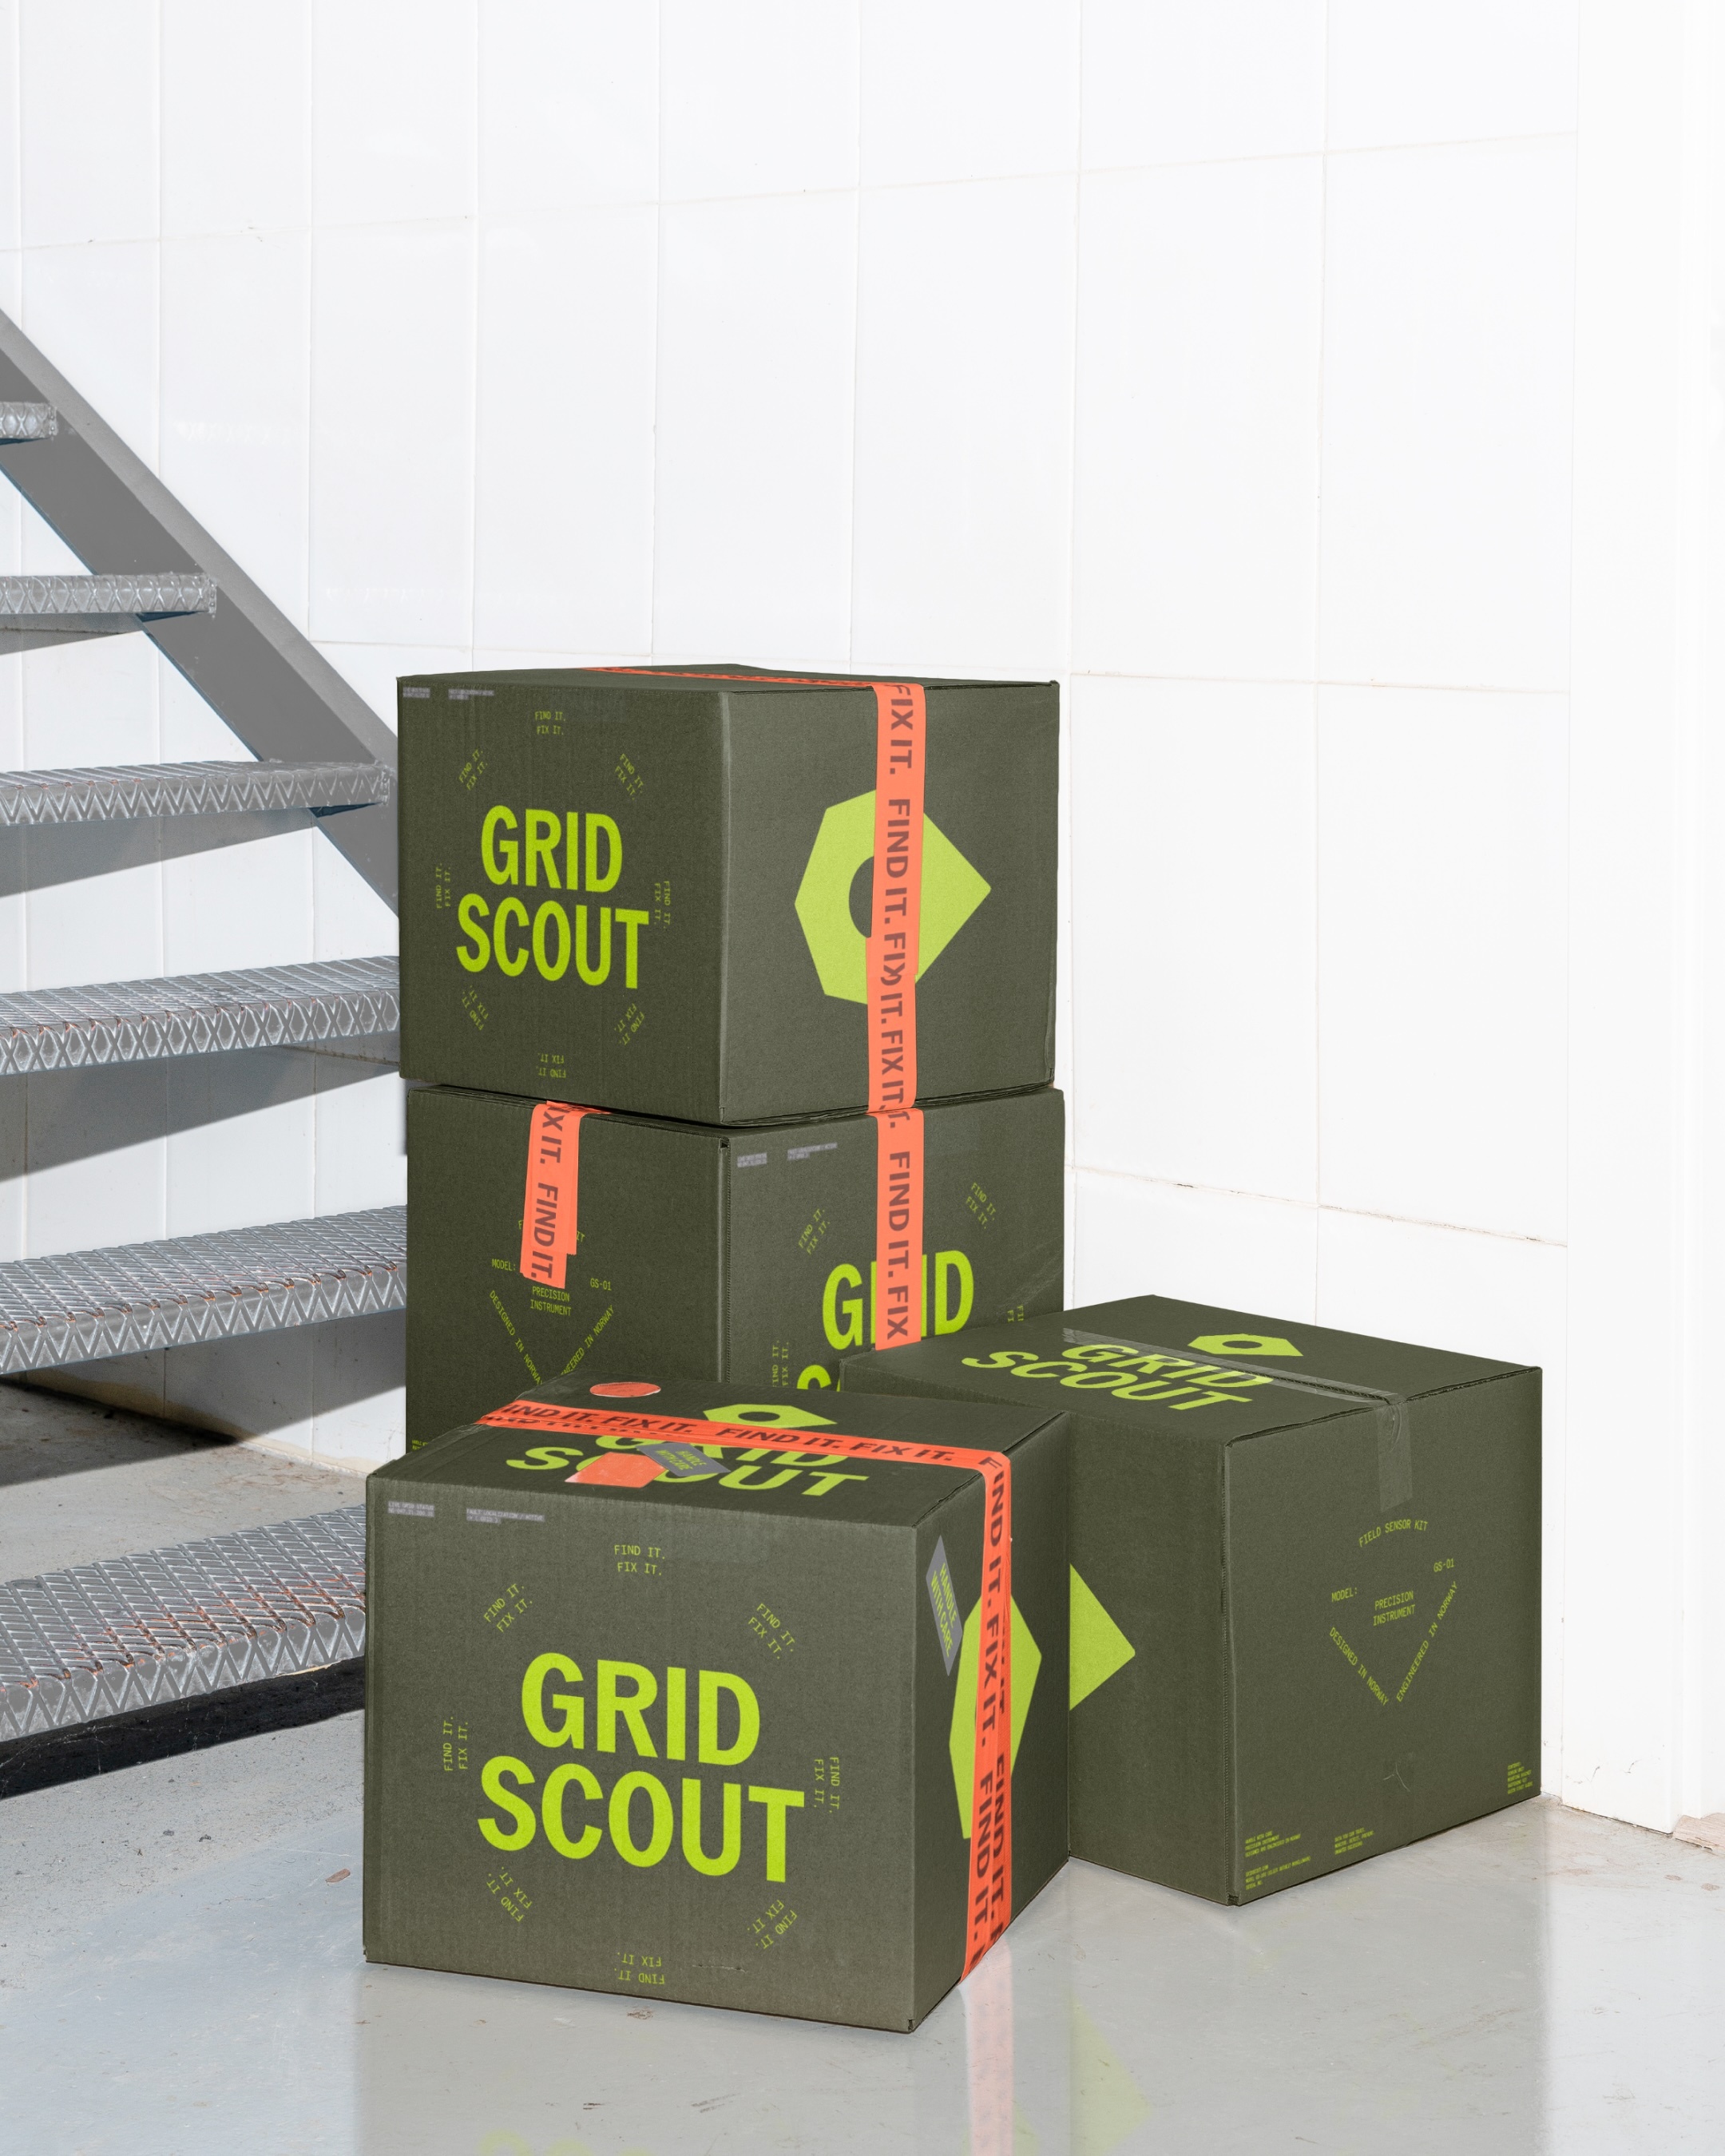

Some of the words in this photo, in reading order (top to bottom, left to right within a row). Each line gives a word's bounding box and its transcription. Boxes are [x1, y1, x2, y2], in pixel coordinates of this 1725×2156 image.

[535, 711, 551, 720] FIND
[890, 686, 914, 731] FIX
[537, 725, 549, 735] FIX
[621, 754, 634, 774] FIND
[889, 739, 913, 775] IT.
[459, 763, 471, 783] FIND
[466, 774, 477, 790] FIX
[615, 766, 627, 783] FIX
[482, 805, 622, 892] GRID
[886, 799, 910, 878] FIND
[884, 887, 907, 925] IT.
[456, 894, 648, 989] SCOUT
[478, 1002, 488, 1019] FIX
[626, 1003, 637, 1021] FIX
[880, 993, 903, 1024] IT.
[470, 1010, 484, 1030] FIND
[631, 1011, 644, 1032] FIND
[553, 1055, 564, 1064] FIX
[881, 1029, 903, 1076] FIX
[550, 1068, 566, 1078] FIND
[543, 1106, 571, 1132] IX
[540, 1135, 564, 1165] IT.
[888, 1151, 910, 1231] FIND
[971, 1183, 986, 1203] FIND
[533, 1182, 559, 1246] FIND
[966, 1196, 978, 1213] FIX
[798, 1224, 813, 1249] FIND
[807, 1236, 818, 1254] FIX
[491, 1258, 516, 1271] MODEL:
[530, 1250, 554, 1278] IT.
[886, 1239, 910, 1278] IT.
[533, 1286, 570, 1302] PRECISION
[590, 1278, 612, 1291] GS-01
[530, 1299, 572, 1316] INSTRUMENT
[886, 1285, 909, 1341] FIX
[490, 1290, 516, 1336] DESIGNED
[515, 1338, 525, 1353] IN
[585, 1334, 594, 1348] IN
[593, 1304, 613, 1335] NORWAY
[1061, 1344, 1273, 1388] GRID
[962, 1352, 1252, 1410] SCOUT
[502, 1405, 561, 1417] IND
[561, 1412, 600, 1422] IT.
[601, 1417, 661, 1429] FIX
[658, 1422, 697, 1433] IT.
[715, 1428, 800, 1443] FIND
[803, 1437, 843, 1449] IT.
[849, 1442, 914, 1456] FIX
[914, 1449, 954, 1461] IT.
[978, 1456, 1004, 1548] FIND
[1358, 1527, 1381, 1548] FIELD
[1385, 1519, 1410, 1533] SENSOR
[1414, 1519, 1428, 1532] KIT
[614, 1545, 640, 1556] FIND
[648, 1547, 665, 1560] IT.
[617, 1561, 637, 1572] FIX
[644, 1563, 662, 1576] IT.
[1434, 1558, 1454, 1572] GS-01
[988, 1556, 1001, 1608] IT.
[483, 1598, 506, 1623] FIND
[506, 1583, 525, 1598] IT.
[940, 1562, 957, 1629] HANDLE
[1331, 1587, 1357, 1602] MODEL:
[1375, 1591, 1414, 1611] PRECISION
[496, 1612, 515, 1633] FIX
[514, 1599, 533, 1613] IT.
[931, 1570, 943, 1617] WITH
[940, 1611, 953, 1658] CARE
[1373, 1604, 1415, 1627] INSTRUMENT
[748, 1617, 767, 1639] FIX
[767, 1639, 782, 1659] IT.
[756, 1603, 780, 1628] FIND
[781, 1631, 795, 1652] IT.
[984, 1612, 999, 1690] FIX
[1397, 1640, 1429, 1702] ENGINEERED
[1429, 1622, 1438, 1638] IN
[1438, 1581, 1457, 1619] NORWAY
[1330, 1627, 1358, 1666] DESIGNED
[1358, 1664, 1367, 1679] IN
[1367, 1676, 1389, 1706] NORWAY
[521, 1652, 760, 1766] GRID
[443, 1717, 453, 1735] IT.
[981, 1692, 997, 1748] IT.
[458, 1722, 468, 1740] IT.
[443, 1742, 453, 1771] FIND
[458, 1748, 468, 1770] FIX
[814, 1759, 824, 1781] FIX
[830, 1757, 839, 1786] FIND
[814, 1789, 824, 1808] IT.
[829, 1794, 839, 1813] IT.
[478, 1755, 804, 1882] SCOUT
[977, 1770, 993, 1879] FIND
[486, 1873, 501, 1895] IT.
[499, 1866, 514, 1886] IT.
[514, 1887, 532, 1908] FIX
[501, 1896, 525, 1922] FIND
[765, 1900, 784, 1920] FIX
[974, 1885, 989, 1942] IT.
[747, 1918, 766, 1933] IT.
[775, 1909, 797, 1934] FIND
[755, 1934, 774, 1949] IT.
[617, 1952, 634, 1965] IT.
[641, 1956, 661, 1968] FIX
[614, 1968, 631, 1981] IT.
[638, 1972, 664, 1984] FIND
